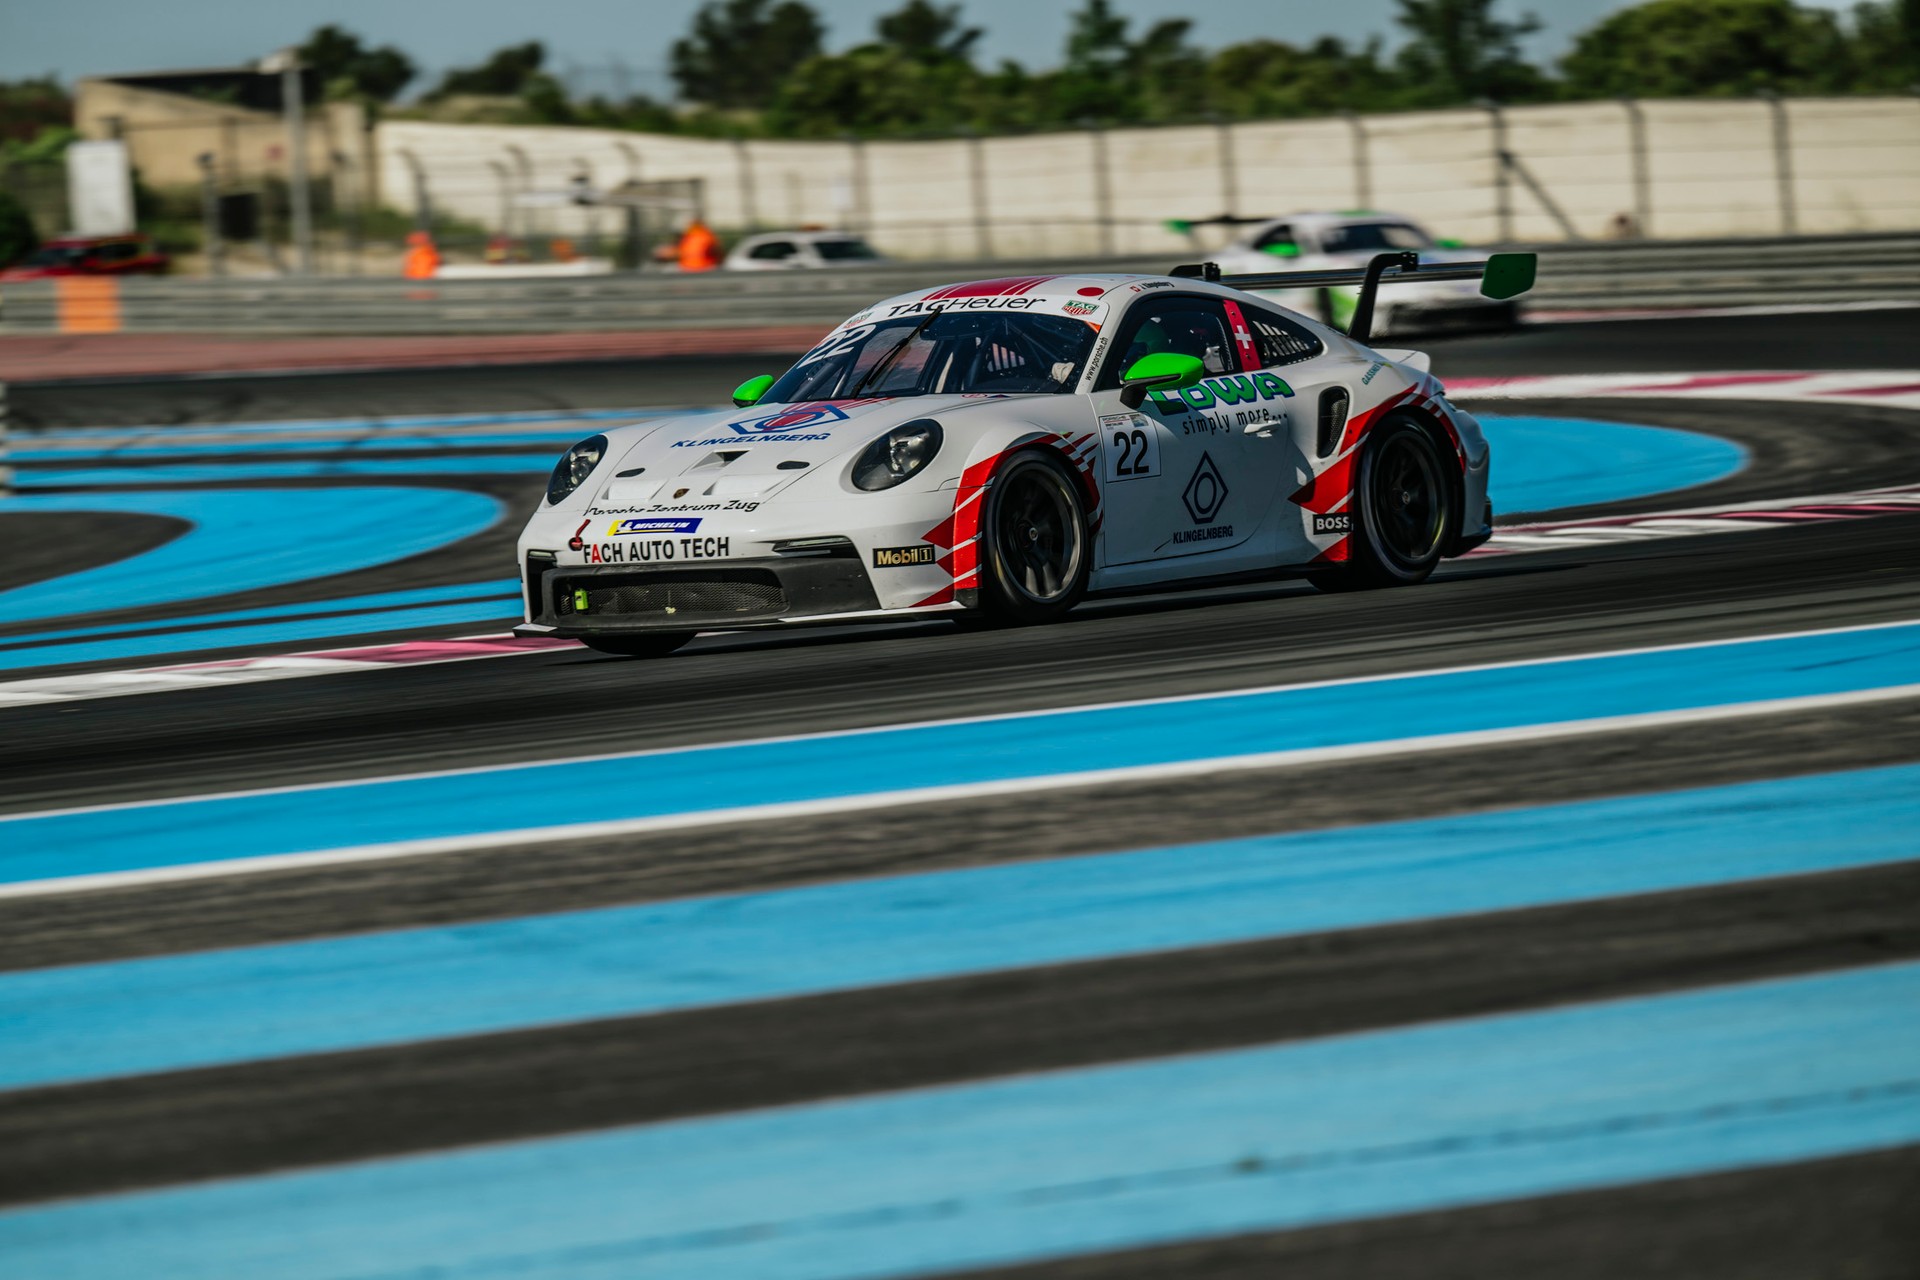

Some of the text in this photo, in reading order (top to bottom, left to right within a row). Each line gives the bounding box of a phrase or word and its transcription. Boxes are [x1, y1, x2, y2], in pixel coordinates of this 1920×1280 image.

[1063, 306, 1093, 315] HEUER
[1070, 301, 1095, 310] TAG
[797, 324, 877, 369] 22
[1182, 411, 1231, 436] simply
[671, 432, 831, 448] KLINGELNBERG
[1113, 429, 1150, 476] 22
[722, 499, 760, 513] Zug
[1316, 516, 1350, 531] BOSS
[1172, 525, 1234, 544] KLINGELNBERG
[583, 536, 730, 564] FACH AUTO TECH
[877, 548, 918, 565] Mobil
